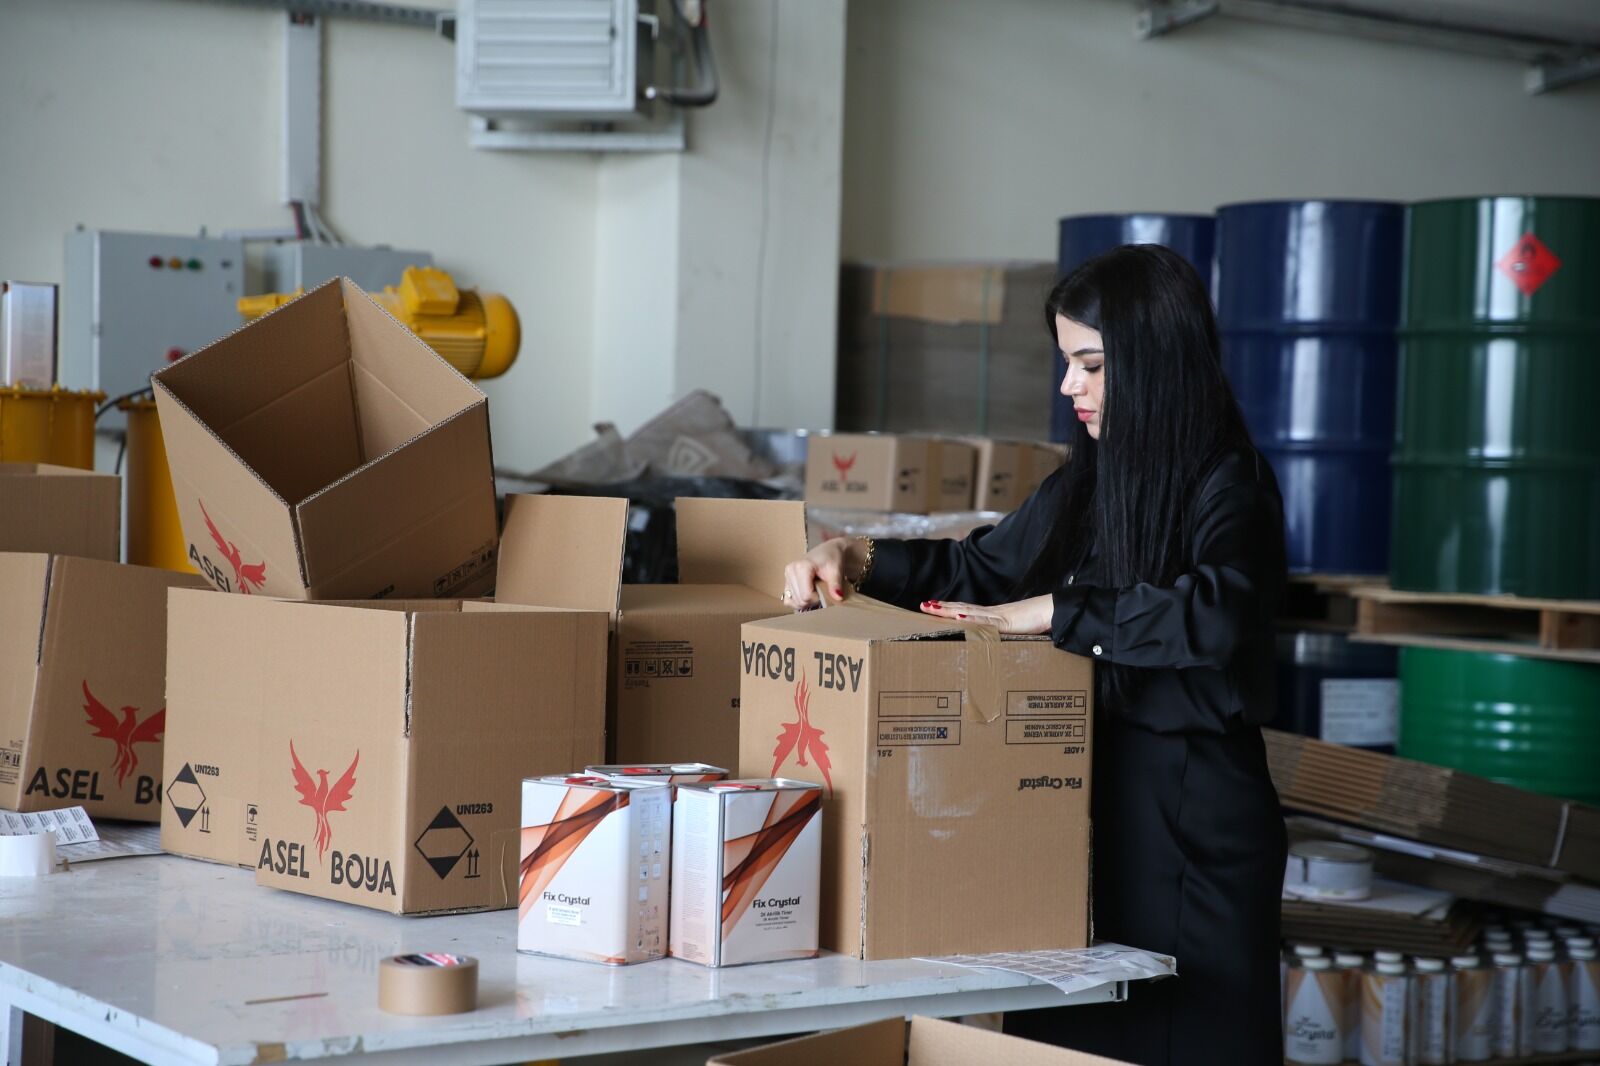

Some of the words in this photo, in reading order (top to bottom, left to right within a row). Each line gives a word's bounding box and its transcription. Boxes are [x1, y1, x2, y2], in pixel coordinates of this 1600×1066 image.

[741, 640, 796, 682] BOYA
[814, 651, 864, 693] ASEL
[194, 763, 220, 777] UN1263
[25, 766, 104, 801] ASEL
[1018, 775, 1063, 791] Crystal
[1064, 777, 1083, 789] Fix
[456, 802, 493, 816] UN1263
[257, 838, 310, 879] ASEL
[330, 850, 397, 896] BOYA
[543, 891, 556, 901] Fix
[557, 893, 590, 906] Crystal
[752, 898, 766, 909] Fix
[768, 896, 800, 909] Crystal
